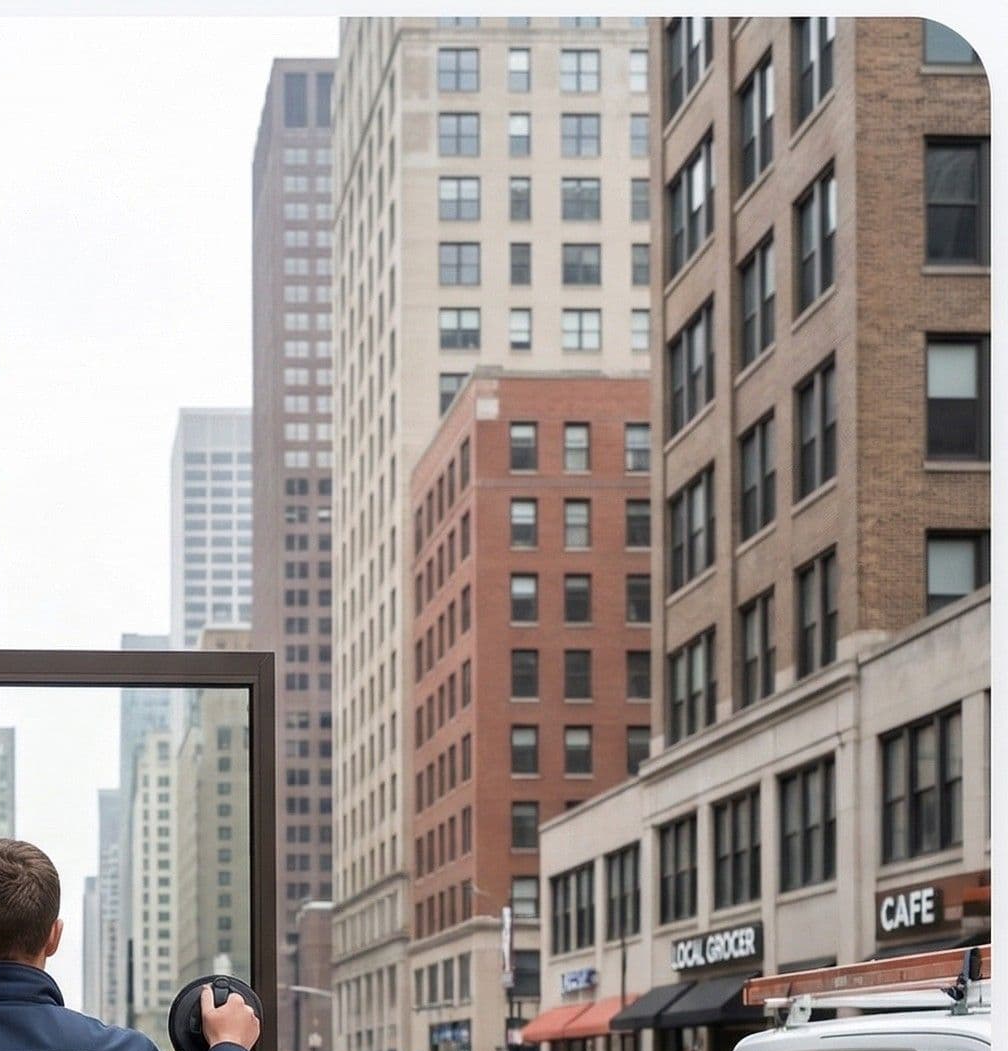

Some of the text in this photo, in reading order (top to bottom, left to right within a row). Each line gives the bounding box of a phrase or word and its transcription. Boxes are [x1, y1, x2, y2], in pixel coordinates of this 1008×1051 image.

[880, 887, 935, 932] CAFE
[672, 927, 756, 970] LOCAL GROCER
